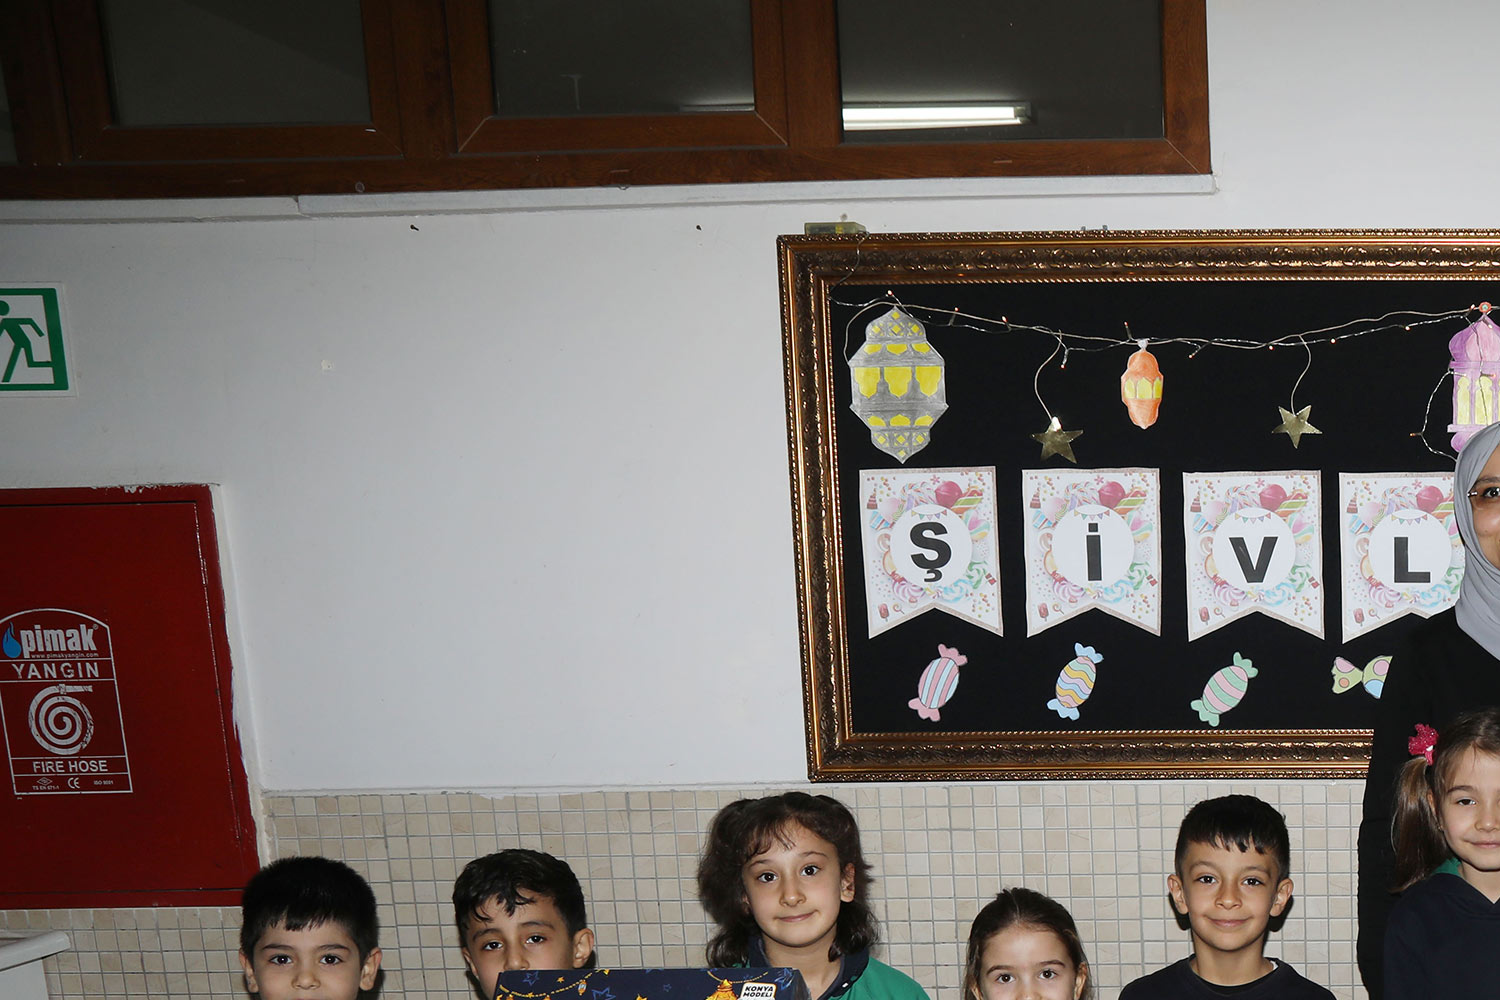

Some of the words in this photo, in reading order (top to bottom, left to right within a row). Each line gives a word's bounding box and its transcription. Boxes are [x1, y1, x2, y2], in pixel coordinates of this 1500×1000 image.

[20, 624, 97, 658] pimak
[12, 662, 99, 679] YANGIN
[33, 761, 65, 773] FIRE
[69, 760, 108, 773] HOSE
